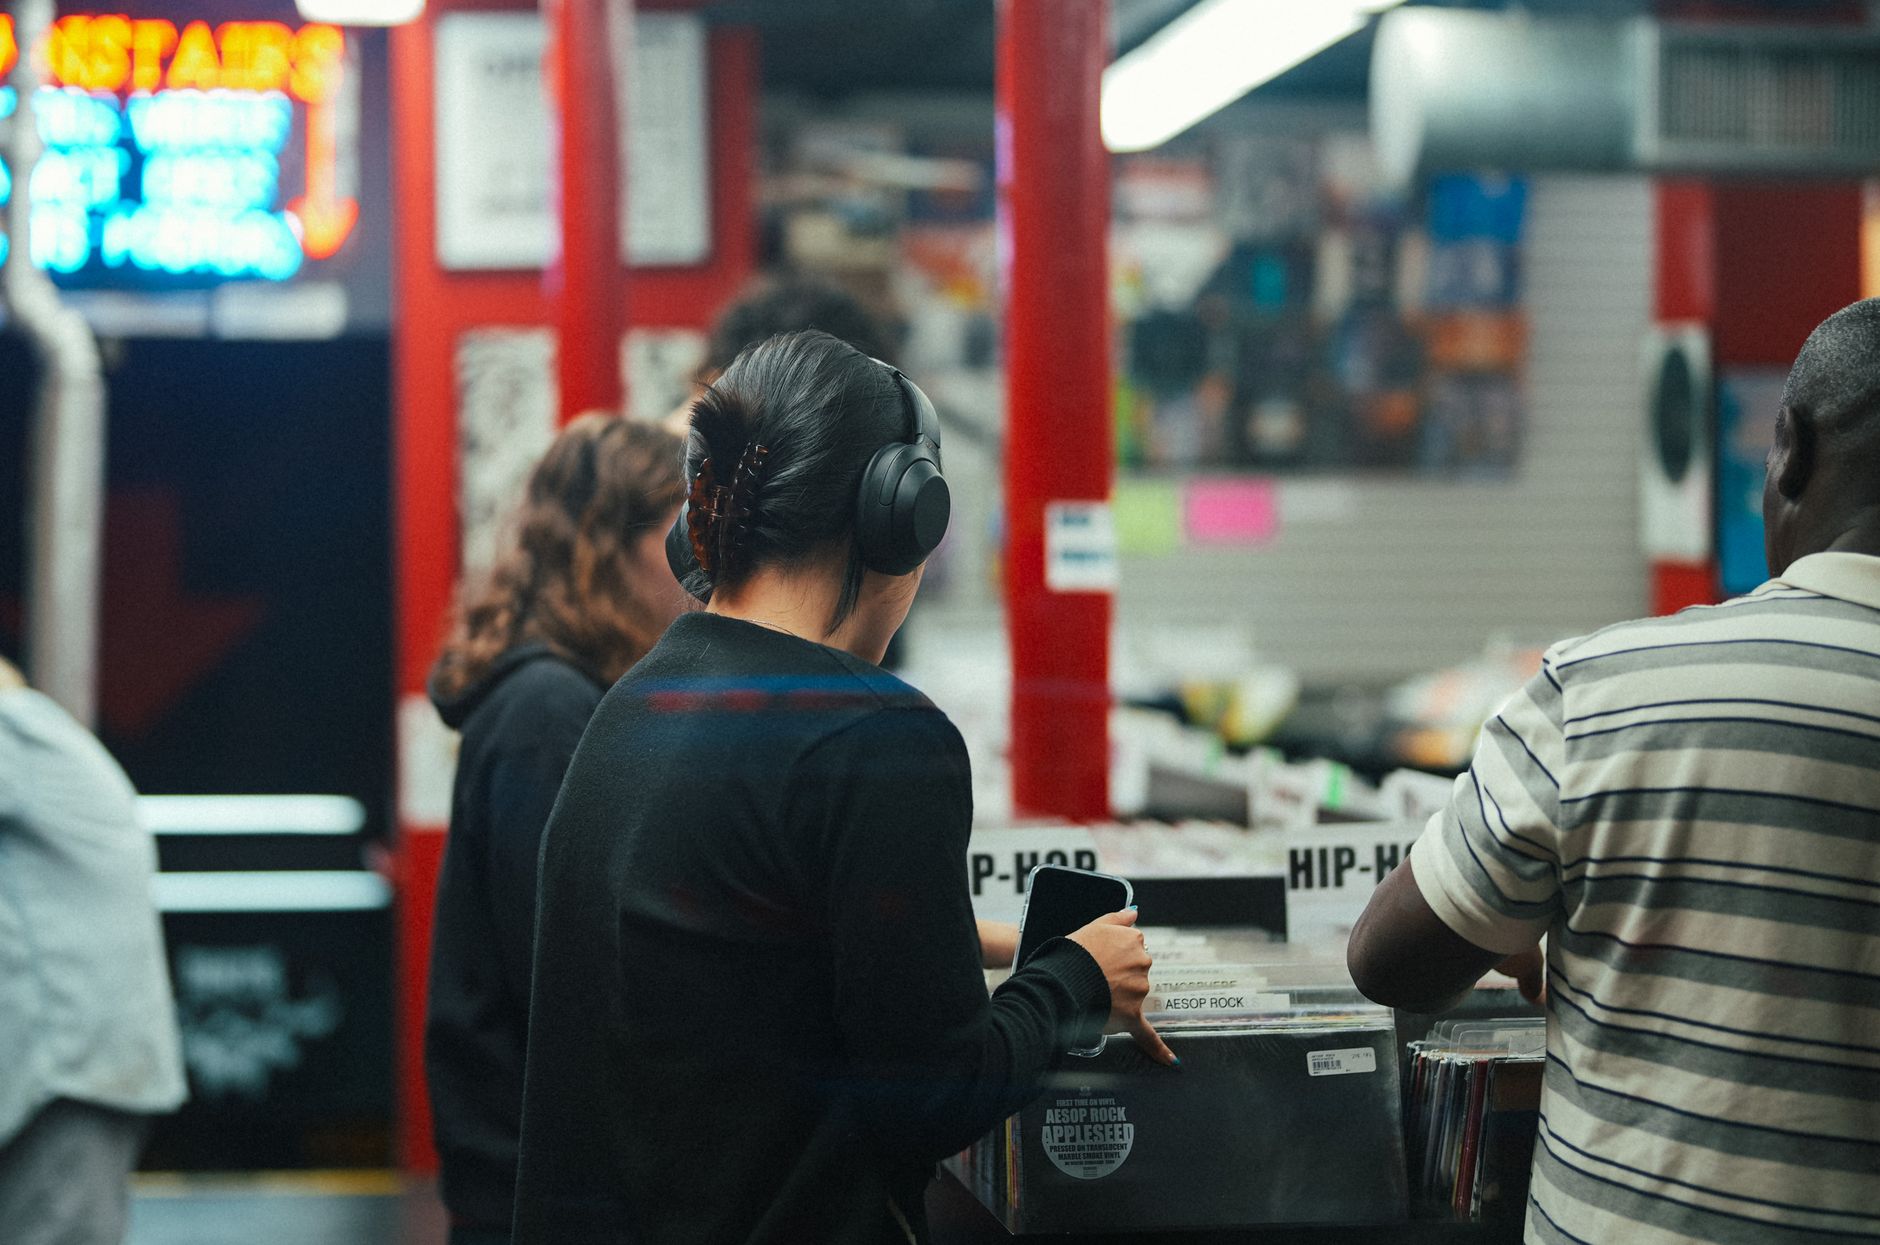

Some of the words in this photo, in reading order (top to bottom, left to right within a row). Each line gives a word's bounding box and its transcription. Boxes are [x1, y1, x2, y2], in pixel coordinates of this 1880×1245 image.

[0, 14, 344, 102] NSTAIRS
[1290, 841, 1415, 889] HIP-H
[1165, 998, 1207, 1010] AESOP
[1210, 997, 1244, 1008] ROCK
[1098, 1098, 1115, 1106] VINYL
[1046, 1108, 1087, 1124] AESOP
[1090, 1107, 1127, 1122] ROCK
[1042, 1123, 1134, 1144] APPLESEED
[1087, 1143, 1128, 1152] TRANSLUCENT
[1104, 1151, 1120, 1159] VINYL
